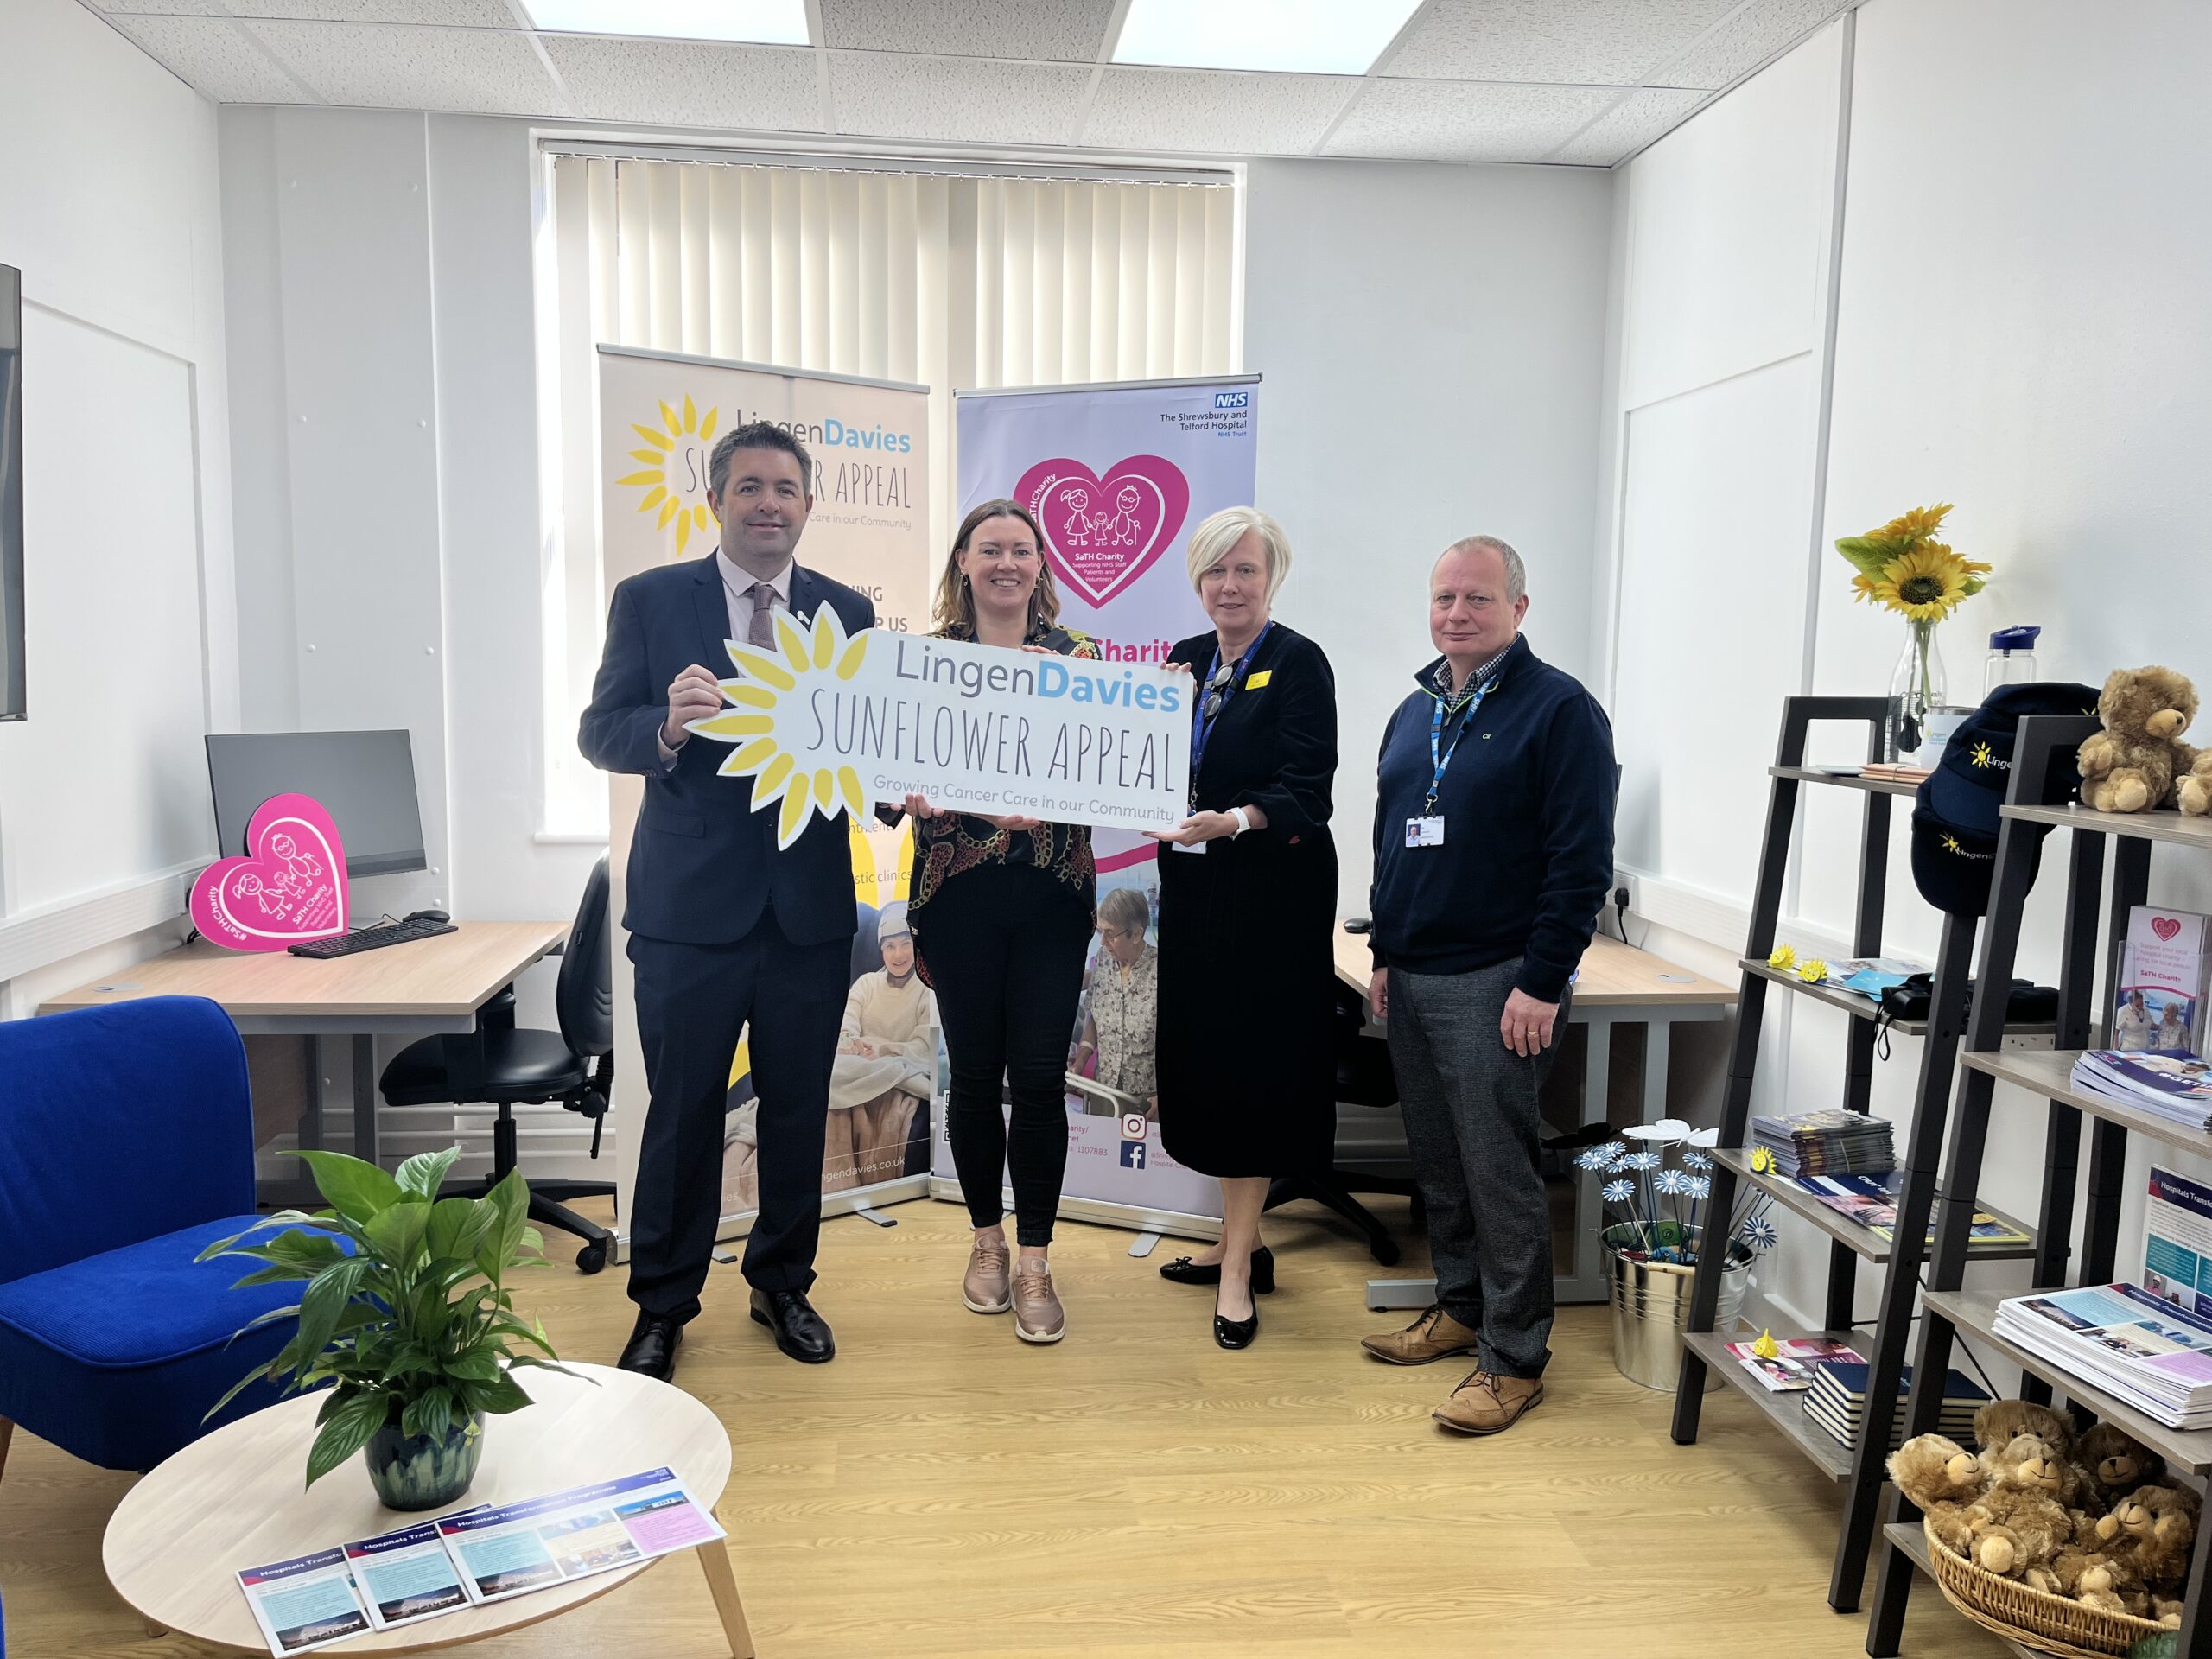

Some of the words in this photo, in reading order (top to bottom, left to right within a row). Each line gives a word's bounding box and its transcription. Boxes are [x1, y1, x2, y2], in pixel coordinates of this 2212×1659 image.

[1216, 393, 1247, 407] NHS
[1178, 411, 1229, 422] Shrewsbury
[1230, 410, 1247, 419] and
[1180, 422, 1209, 431] Telford
[1211, 420, 1247, 430] Hospital
[835, 463, 911, 508] APPEAL
[1029, 474, 1056, 523] aTHCharity
[809, 512, 831, 524] Care
[833, 513, 842, 524] in
[843, 515, 859, 524] our
[861, 516, 912, 531] Community
[1096, 552, 1125, 562] Charity
[888, 616, 908, 632] US
[896, 639, 1180, 713] LingenDavies
[1471, 697, 1481, 713] NHS
[806, 688, 1031, 778] SUNFLOWER
[1047, 722, 1175, 792] APPEAL
[1440, 755, 1451, 770] NHS
[874, 774, 939, 799] Growing
[944, 783, 999, 802] Cancer
[1002, 790, 1038, 807] Care
[1041, 794, 1055, 810] in
[1058, 800, 1085, 812] our
[1089, 799, 1174, 824] Community
[207, 885, 248, 941] #SaTHCharity
[292, 906, 309, 925] SaTH
[306, 883, 328, 907] Charity
[2140, 969, 2157, 978] SaTH
[2158, 973, 2181, 983] Charity
[1068, 1125, 1090, 1134] arity/
[2160, 1181, 2190, 1199] Hospitals
[2190, 1192, 2212, 1208] Transfo
[457, 1515, 499, 1528] Hospitals
[499, 1497, 567, 1518] Transformation
[567, 1484, 617, 1501] Programme
[364, 1536, 408, 1550] Hospitals
[259, 1562, 305, 1577] Hospitals
[306, 1552, 343, 1566] Transfo
